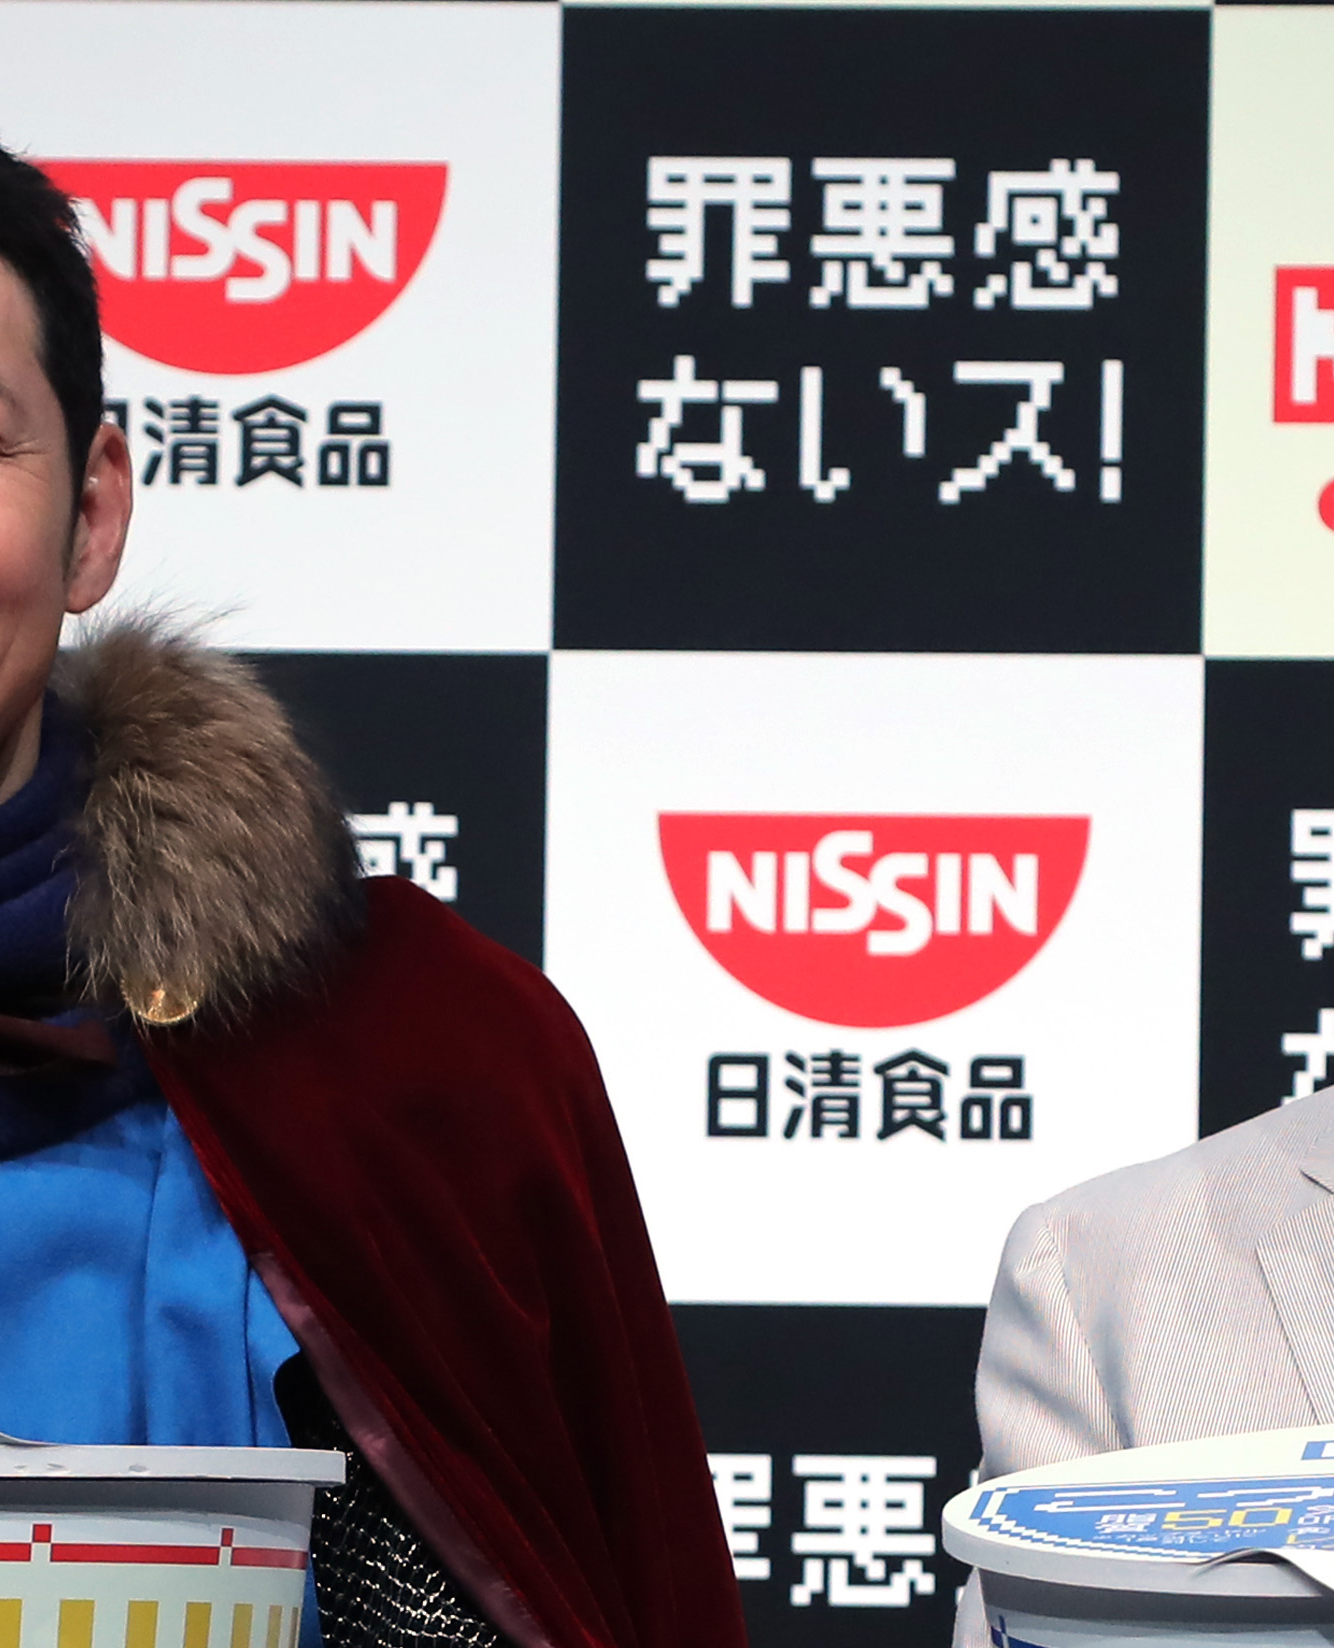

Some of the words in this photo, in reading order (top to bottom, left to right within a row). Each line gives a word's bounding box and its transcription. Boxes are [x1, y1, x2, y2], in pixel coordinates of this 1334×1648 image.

[70, 176, 398, 304] NISSIN
[646, 155, 1118, 309] 罪悪感
[636, 354, 1124, 505] ないス!
[707, 830, 1038, 955] NISSIN
[706, 1048, 1034, 1144] 日清食品
[1162, 1506, 1292, 1531] 50
